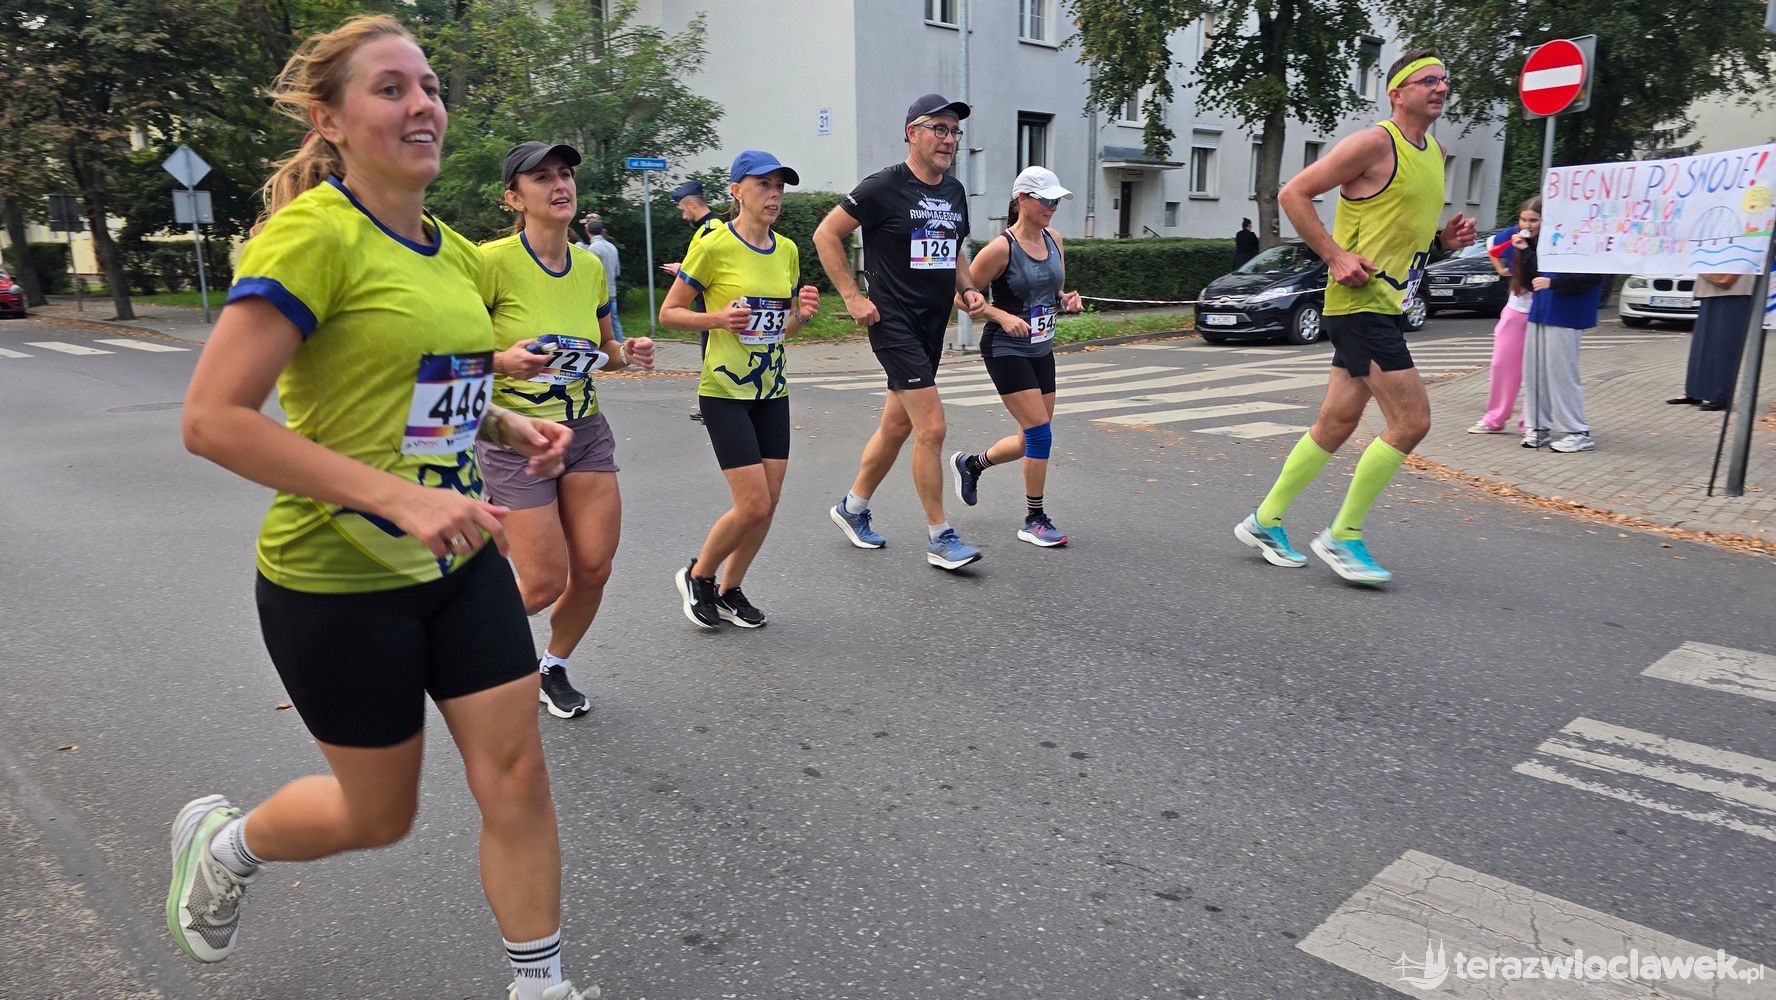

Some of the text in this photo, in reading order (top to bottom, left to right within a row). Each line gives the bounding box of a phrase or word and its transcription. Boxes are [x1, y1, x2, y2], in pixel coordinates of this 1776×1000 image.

[1547, 167, 1637, 201] BIEGNIJ
[921, 240, 950, 257] 126
[751, 311, 785, 331] 733
[544, 351, 600, 373] 727
[428, 380, 487, 425] 446
